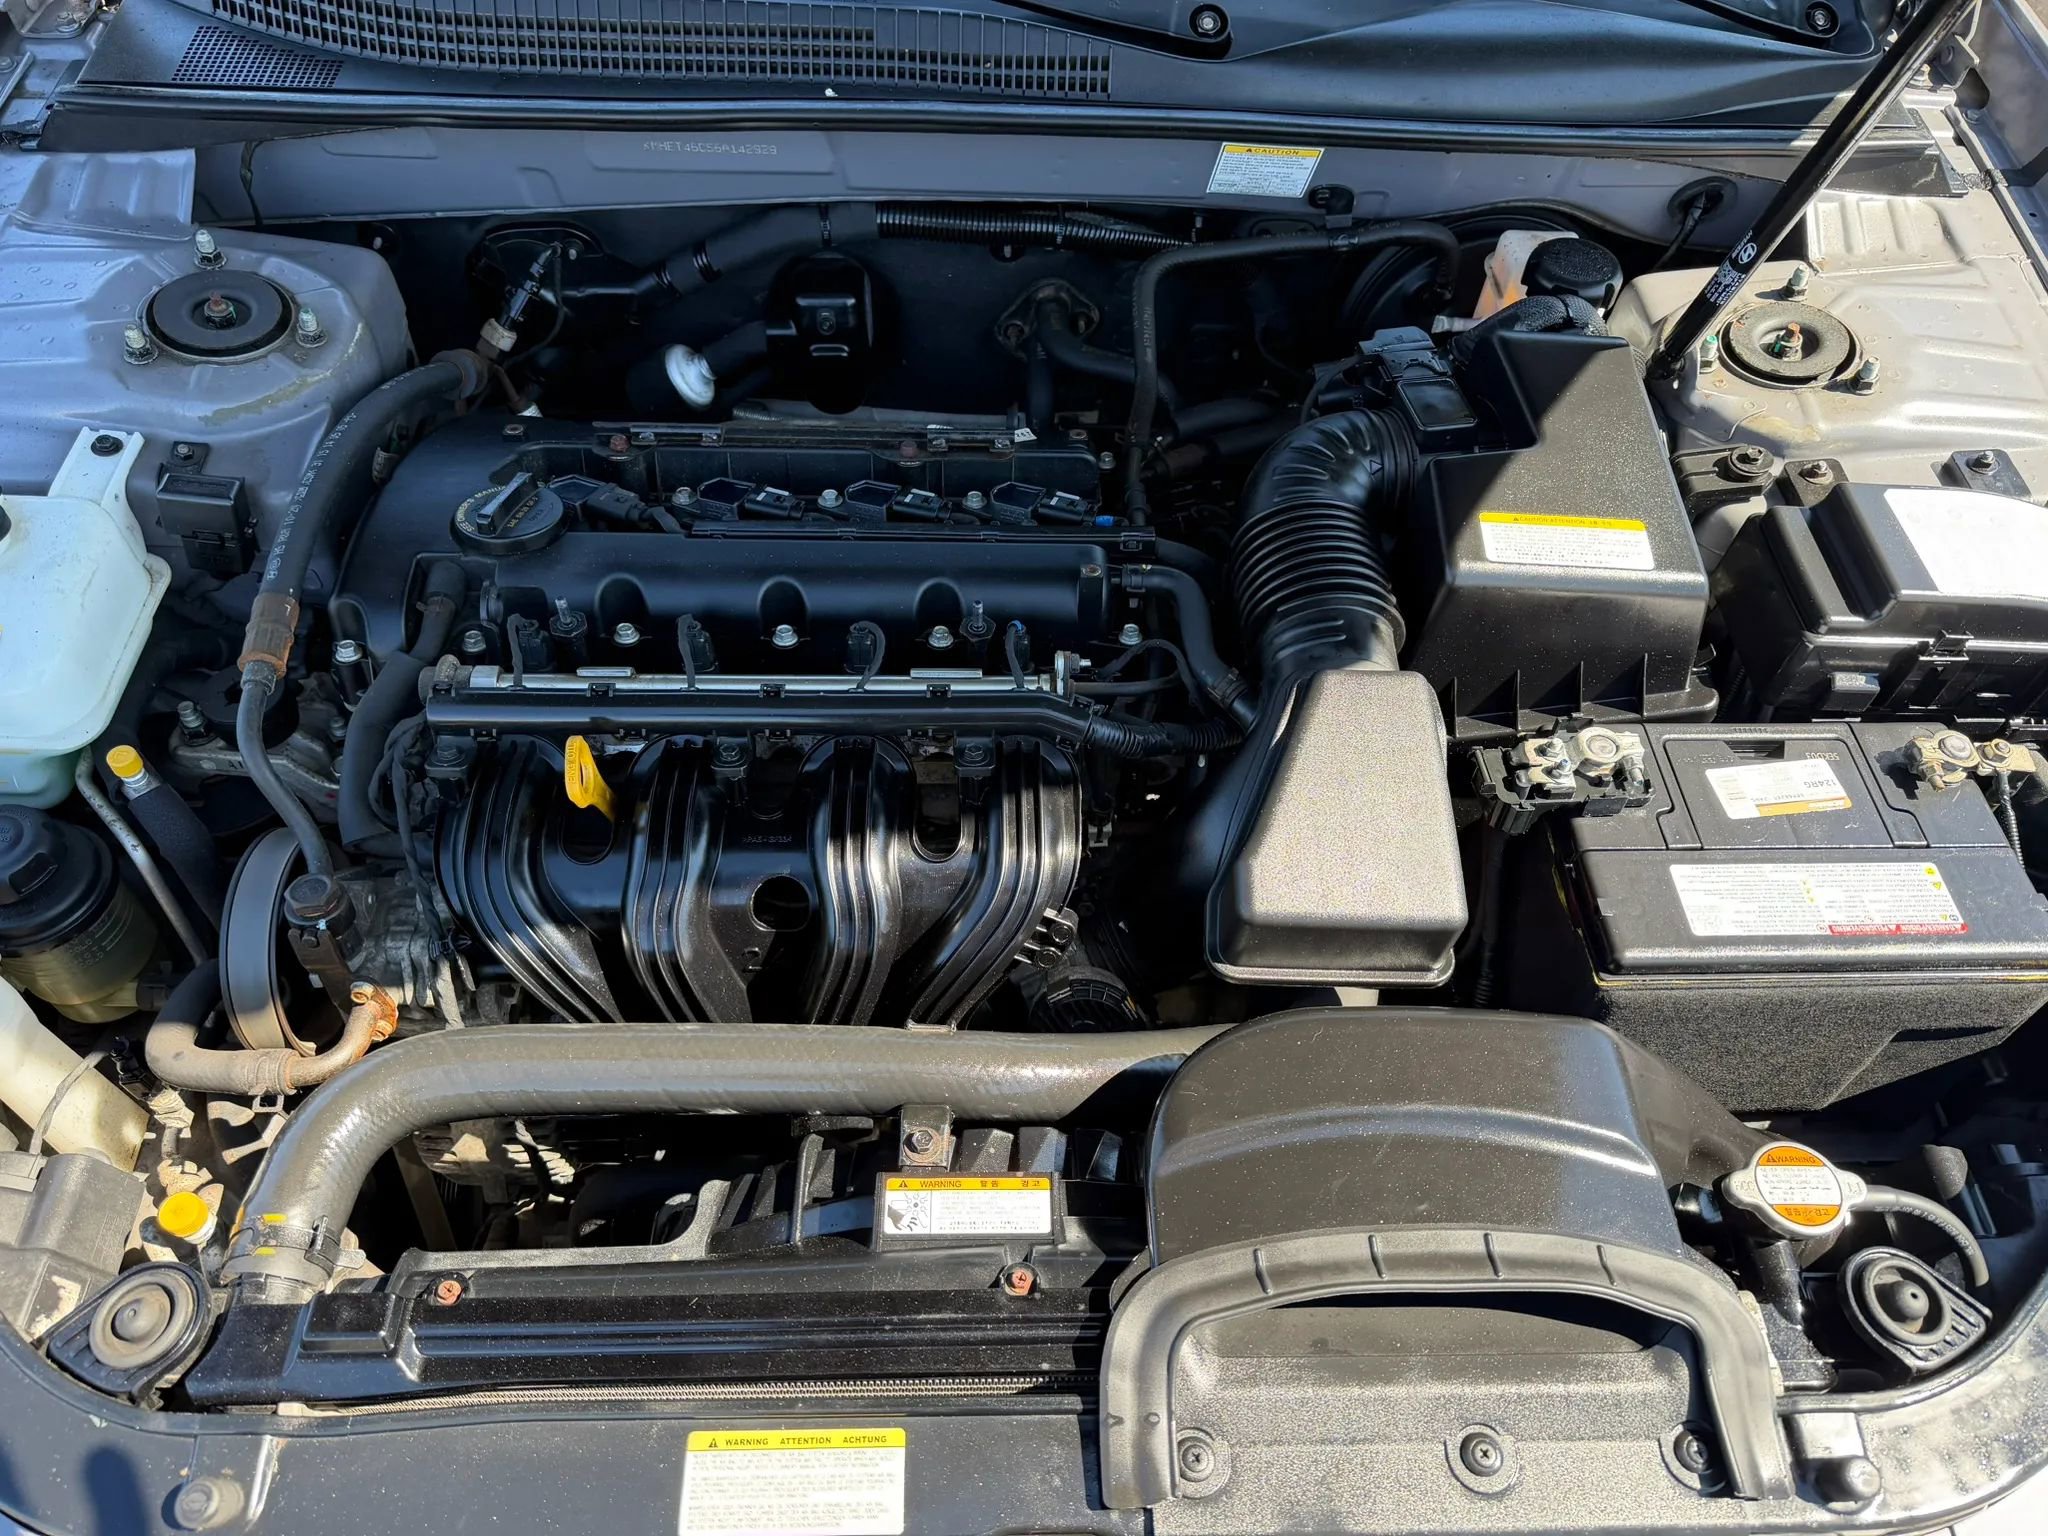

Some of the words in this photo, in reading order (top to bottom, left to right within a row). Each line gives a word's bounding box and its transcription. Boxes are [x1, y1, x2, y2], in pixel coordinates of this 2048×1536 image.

[1254, 148, 1300, 156] CAUTION
[1775, 1155, 1816, 1164] WARNING
[920, 1180, 962, 1188] WARNING
[725, 1438, 769, 1447] WARNING
[779, 1436, 832, 1446] ATTENTION
[842, 1435, 888, 1444] ACHTUNG
